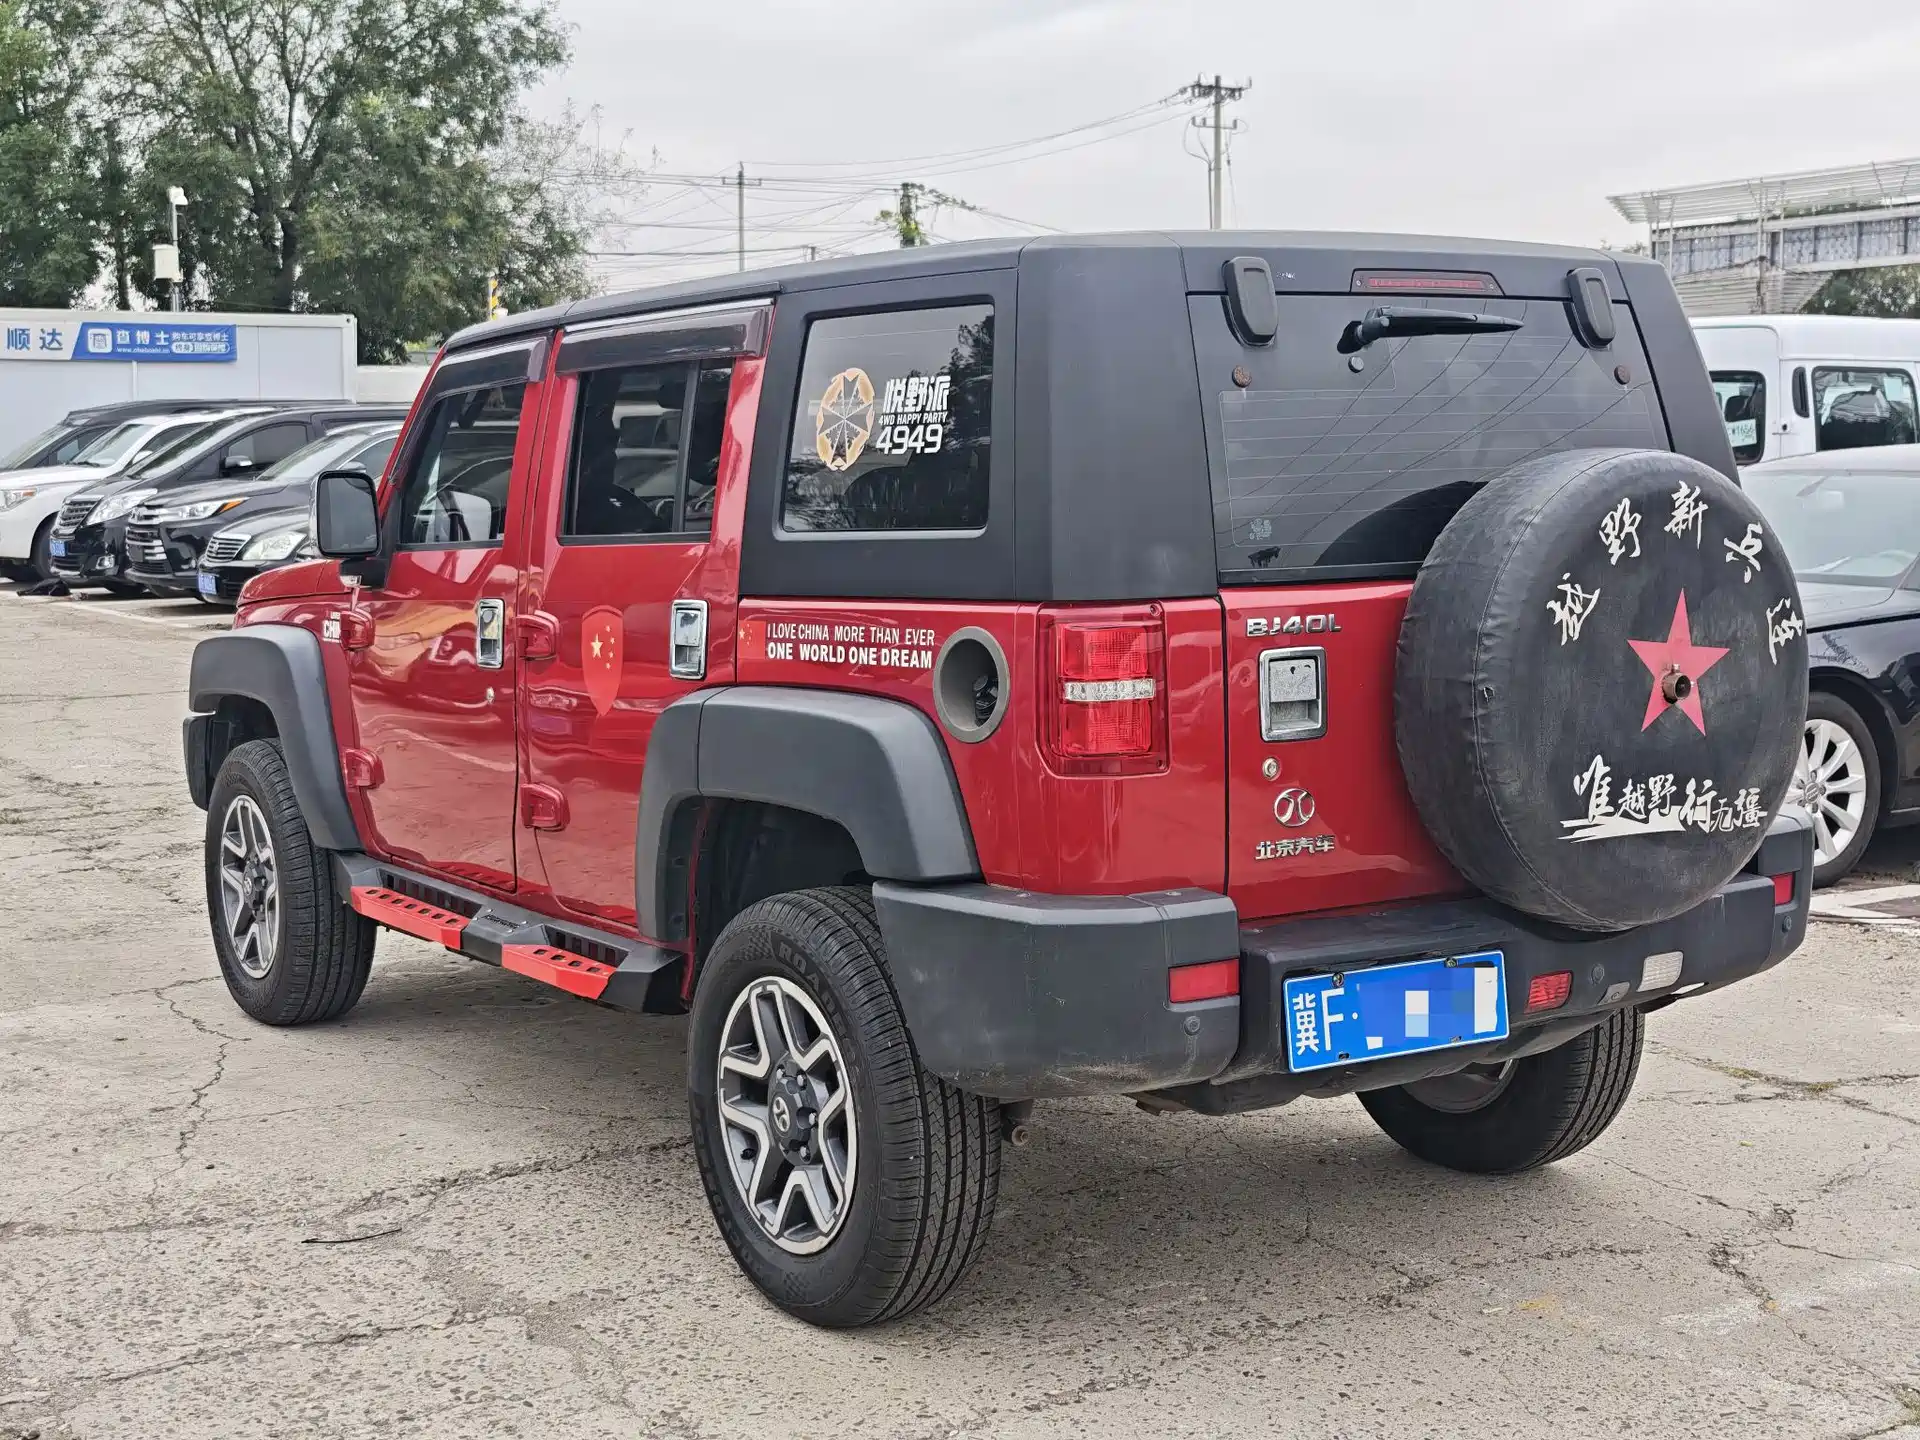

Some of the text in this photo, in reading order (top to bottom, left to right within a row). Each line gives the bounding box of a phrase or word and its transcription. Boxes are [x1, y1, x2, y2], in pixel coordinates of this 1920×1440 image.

[7, 327, 64, 351] 顺达
[116, 330, 169, 346] 查博士
[883, 375, 951, 414] 悦野派
[878, 411, 948, 426] 4WD HAPPY PARTY
[875, 424, 943, 455] 4949
[767, 623, 935, 646] I LOVE CHINA MORE THAN EVER
[1246, 613, 1342, 637] BJ40L
[767, 642, 932, 668] ONE WORLD ONE DREAM
[1255, 834, 1336, 861] 北京汽车
